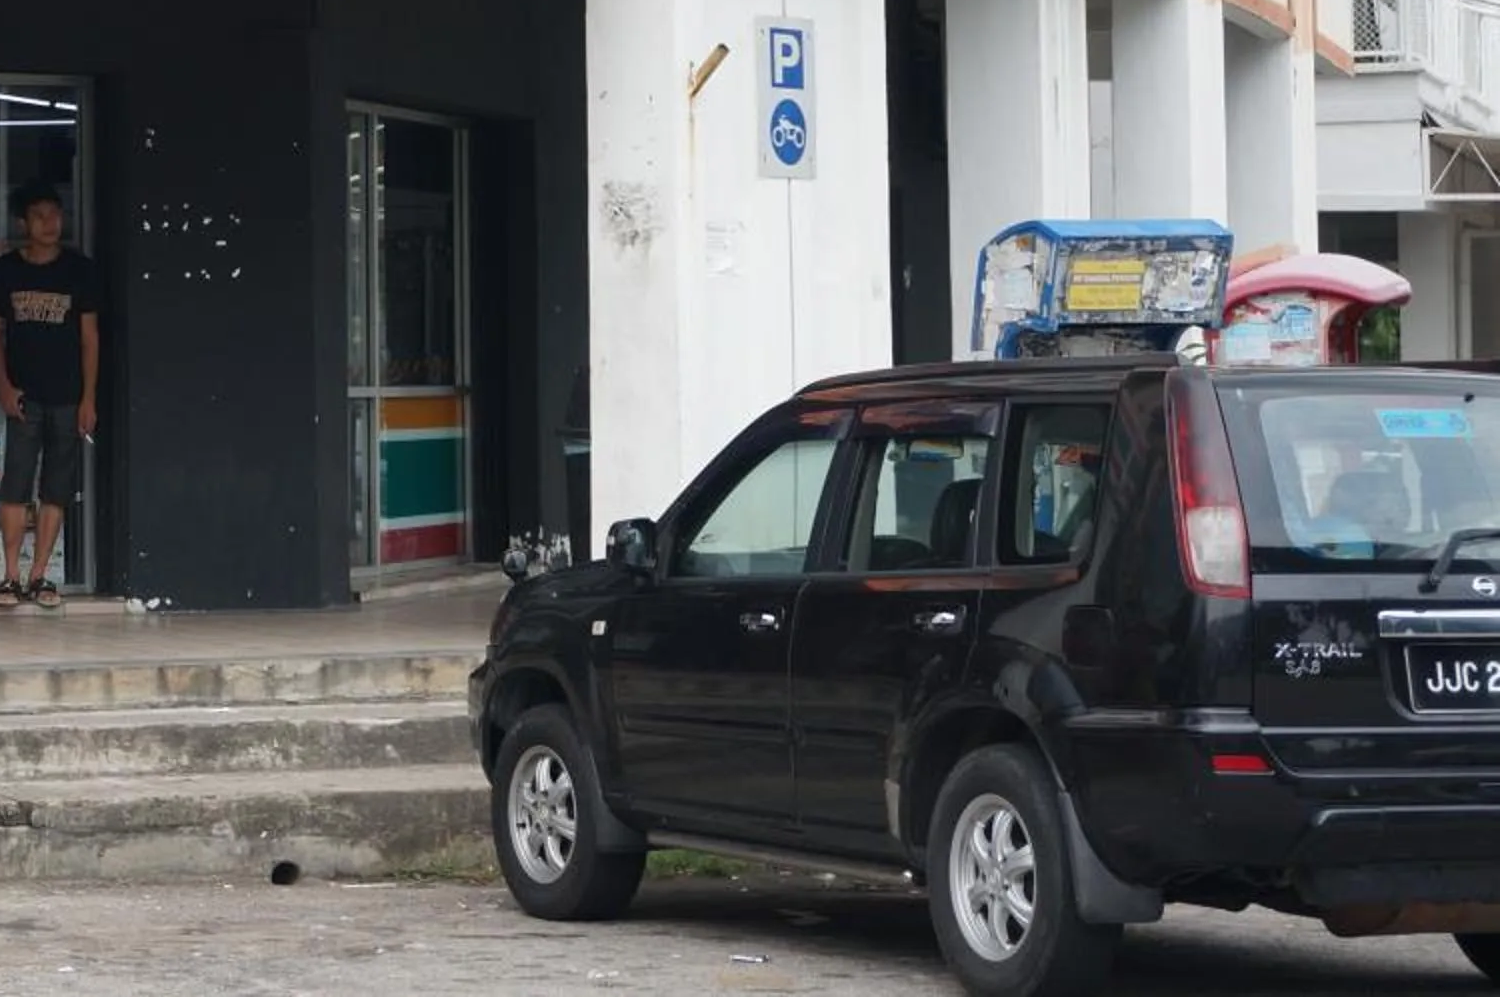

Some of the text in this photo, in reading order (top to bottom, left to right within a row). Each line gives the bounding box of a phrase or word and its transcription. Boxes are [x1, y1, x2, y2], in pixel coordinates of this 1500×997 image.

[773, 32, 800, 84] P
[1274, 641, 1364, 659] X-TRAIL
[1426, 661, 1480, 693] JJC
